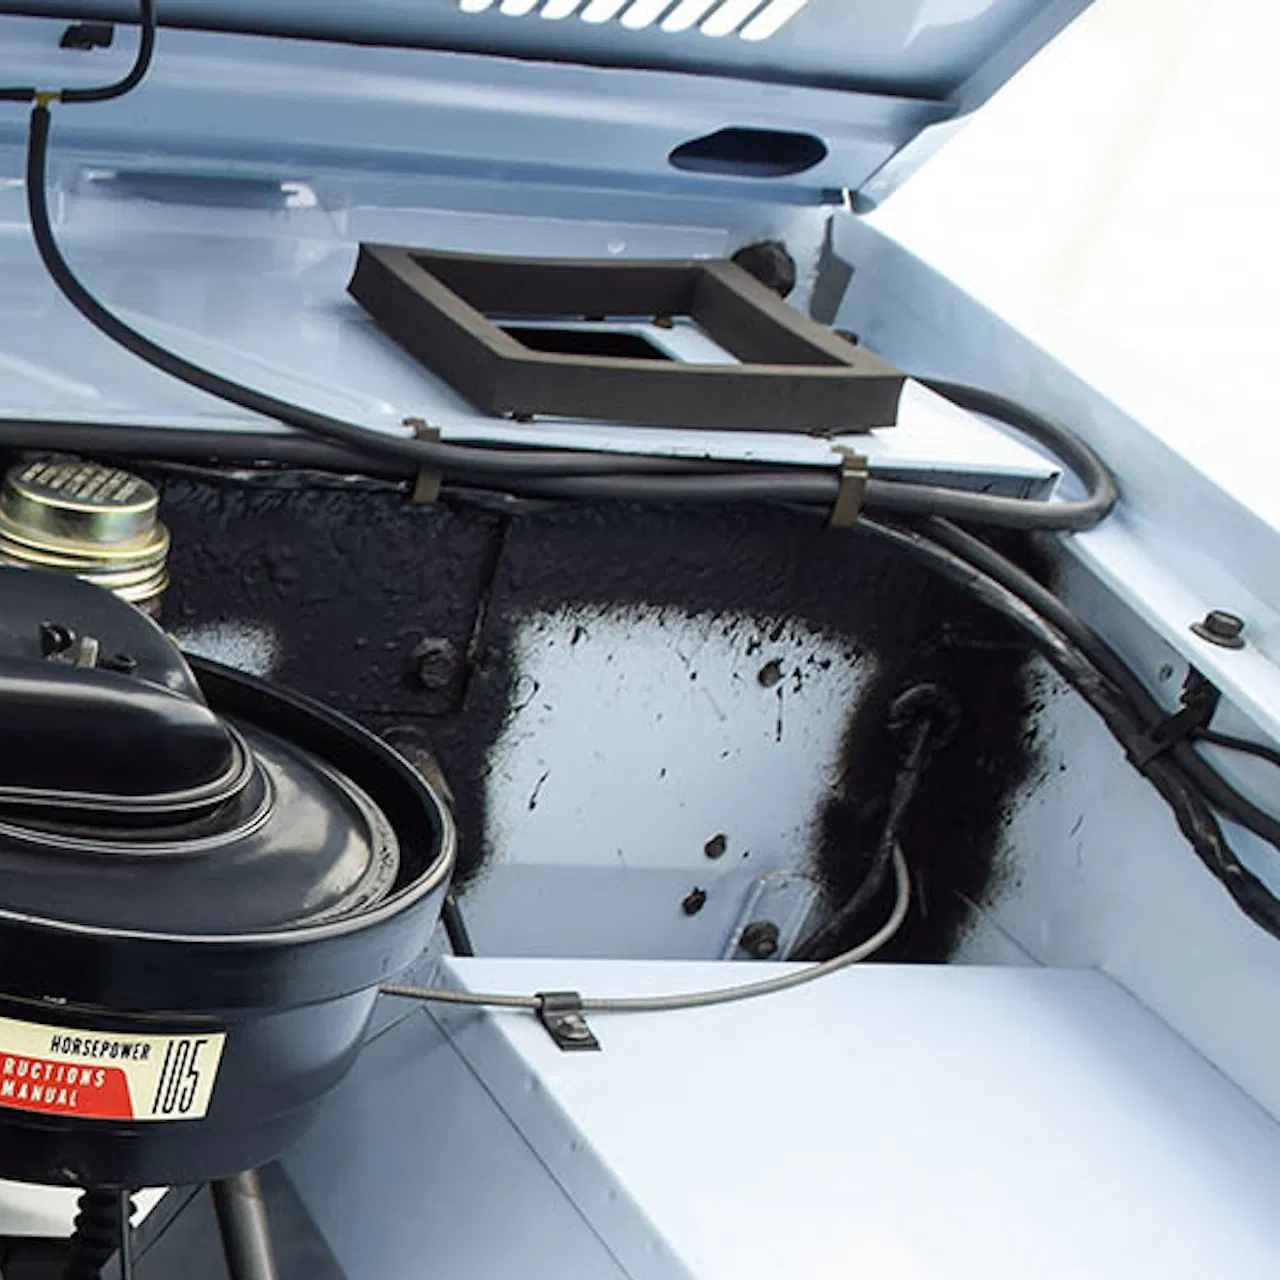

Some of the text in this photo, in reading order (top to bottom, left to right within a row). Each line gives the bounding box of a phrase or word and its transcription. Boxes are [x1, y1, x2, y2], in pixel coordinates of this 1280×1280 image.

[51, 1035, 152, 1060] HORSEPOWER
[152, 1039, 208, 1114] 105
[0, 1079, 80, 1108] MANUAL
